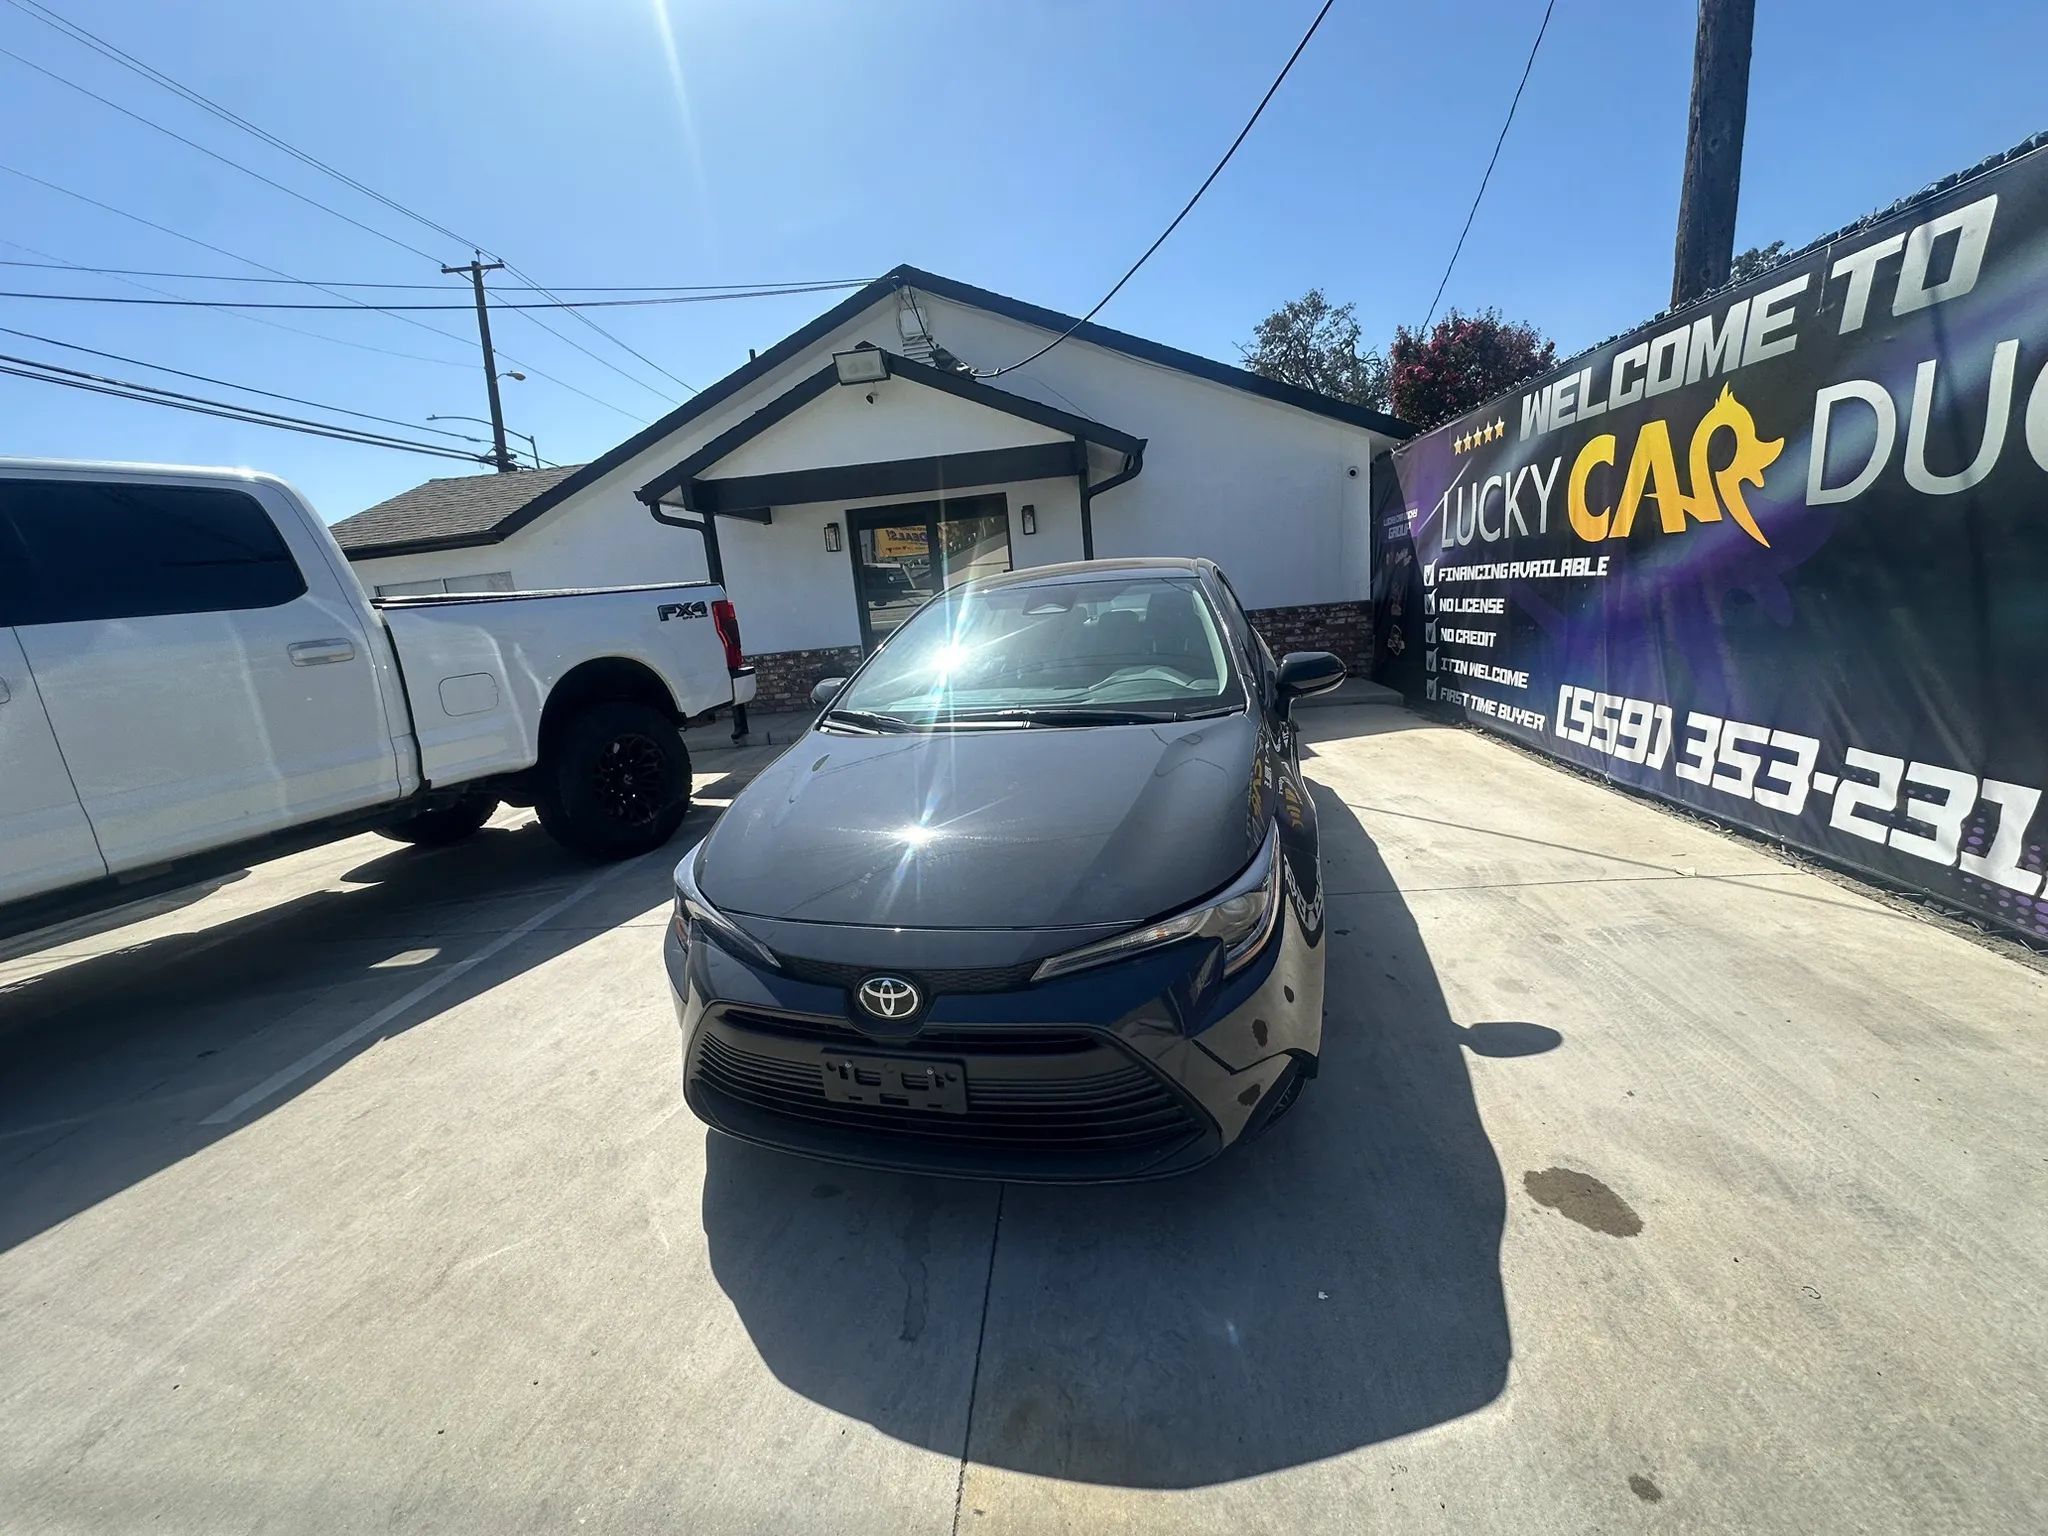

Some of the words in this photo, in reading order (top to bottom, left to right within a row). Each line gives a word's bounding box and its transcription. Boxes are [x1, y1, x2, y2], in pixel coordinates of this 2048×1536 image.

[1519, 273, 1808, 441] WELCOME
[1831, 194, 1998, 335] TO
[1441, 456, 1562, 549] LUCKY
[1568, 381, 1785, 549] CAR
[1805, 338, 2048, 506] DU
[1438, 562, 1509, 583] FINANCING
[1509, 556, 1610, 579] AVAILABLE
[657, 601, 708, 621] FX4
[1439, 598, 1453, 613] NO
[1455, 598, 1505, 615] LICENSE
[1440, 627, 1454, 642] NO
[1455, 630, 1497, 648] CREDIT
[1440, 657, 1469, 676] ITIN
[1469, 661, 1530, 689] WELCOME
[1440, 687, 1470, 707] FIRST
[1470, 693, 1498, 717] TIME
[1498, 703, 1546, 732] BUYER
[1555, 684, 1673, 771] (559)
[1675, 710, 2048, 900] 353-231
